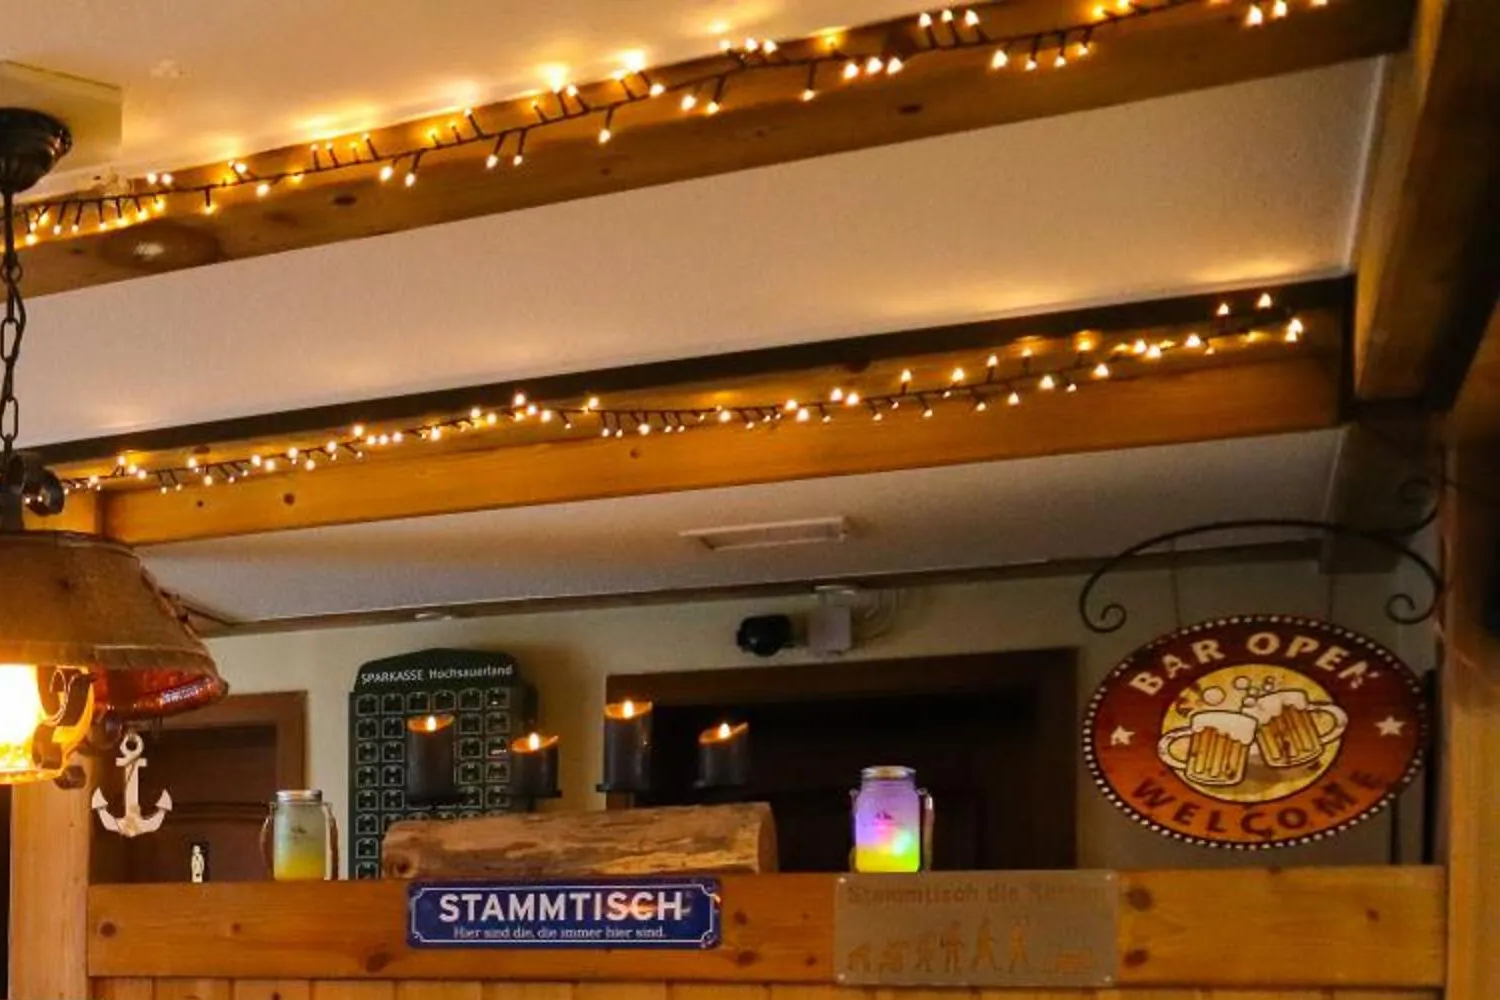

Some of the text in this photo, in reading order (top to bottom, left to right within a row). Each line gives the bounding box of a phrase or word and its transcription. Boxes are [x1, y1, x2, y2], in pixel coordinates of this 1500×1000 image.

[361, 664, 514, 685] SPARKASSE Hochsauerland
[1128, 637, 1226, 697] BAR
[1130, 769, 1388, 841] WELCOME
[438, 890, 683, 923] STAMMTISCH
[453, 926, 481, 939] Hier
[484, 926, 510, 939] sind
[537, 926, 558, 939] die
[561, 926, 602, 939] immer
[606, 926, 632, 939] hier
